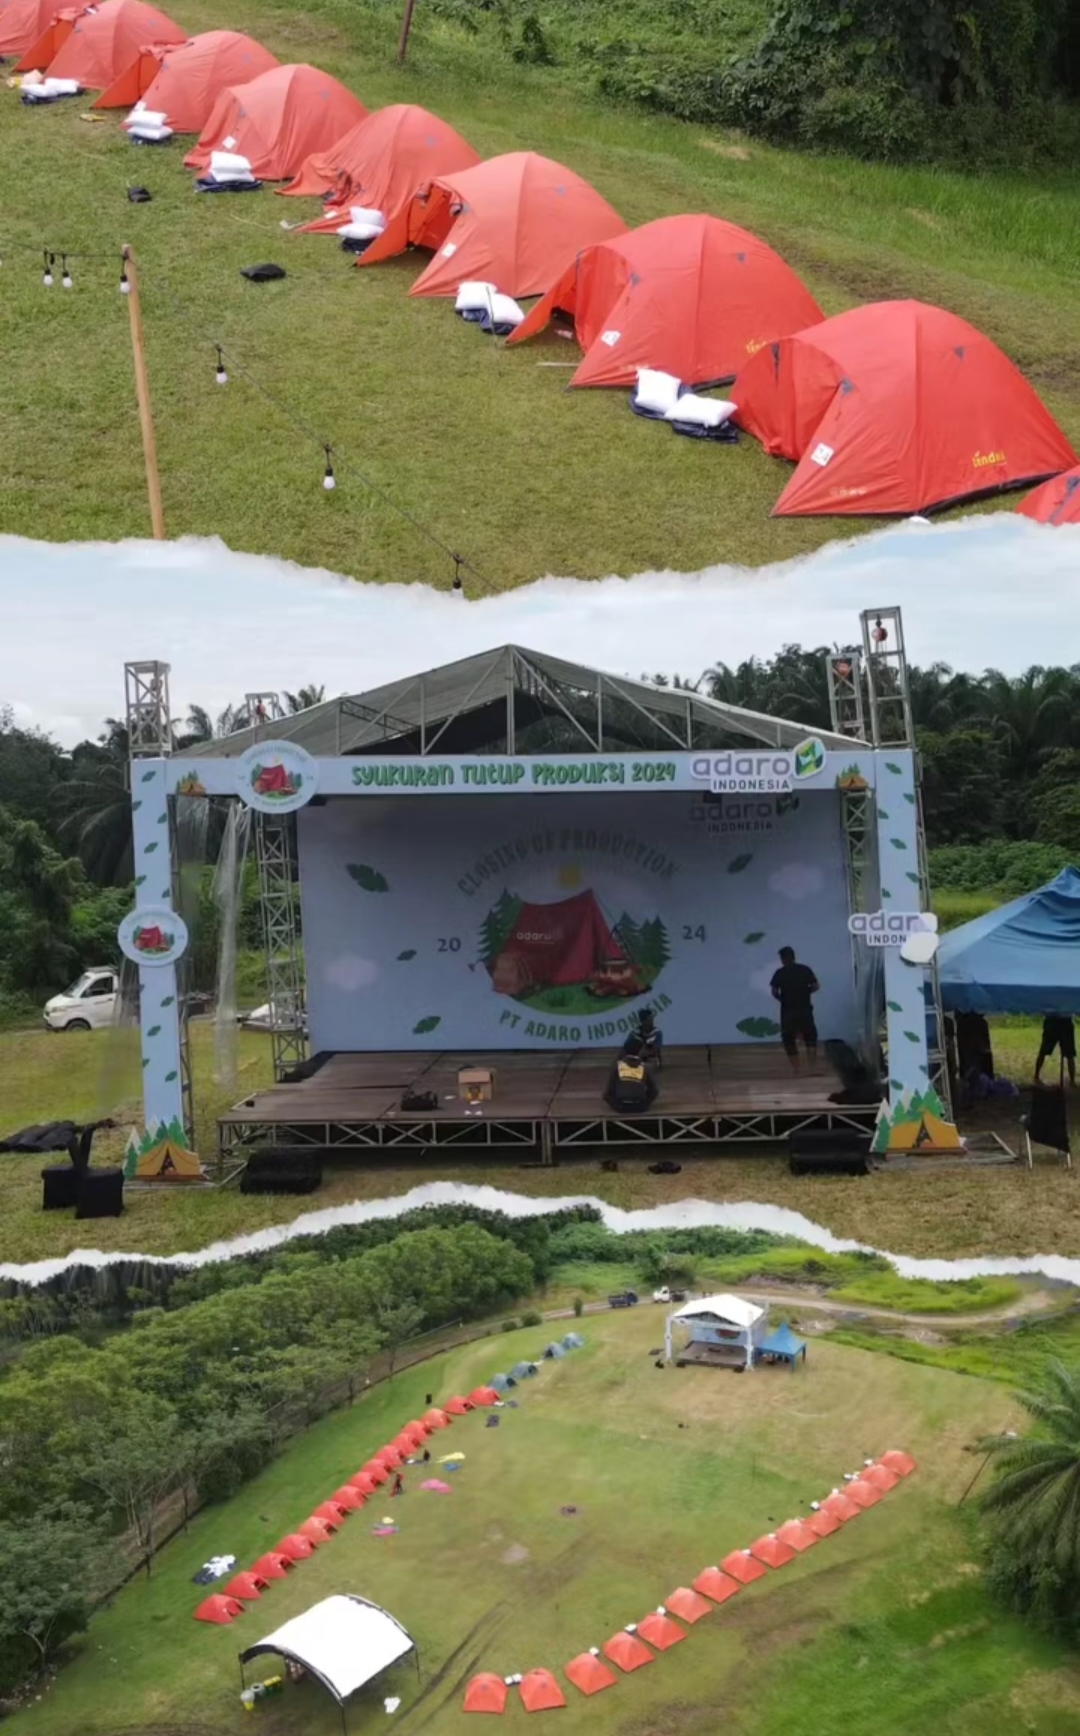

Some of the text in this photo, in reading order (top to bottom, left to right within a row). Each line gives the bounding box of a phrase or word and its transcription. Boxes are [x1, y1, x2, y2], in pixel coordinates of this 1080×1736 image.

[631, 762, 676, 782] 2024
[692, 753, 791, 776] adaro
[713, 779, 791, 791] INDONESIA
[707, 821, 773, 833] INDONESIA
[850, 912, 920, 932] adar
[683, 925, 706, 942] 24
[868, 934, 908, 944] INDON
[437, 938, 461, 952] 20
[499, 993, 673, 1042] PT ADARO INDONSIA
